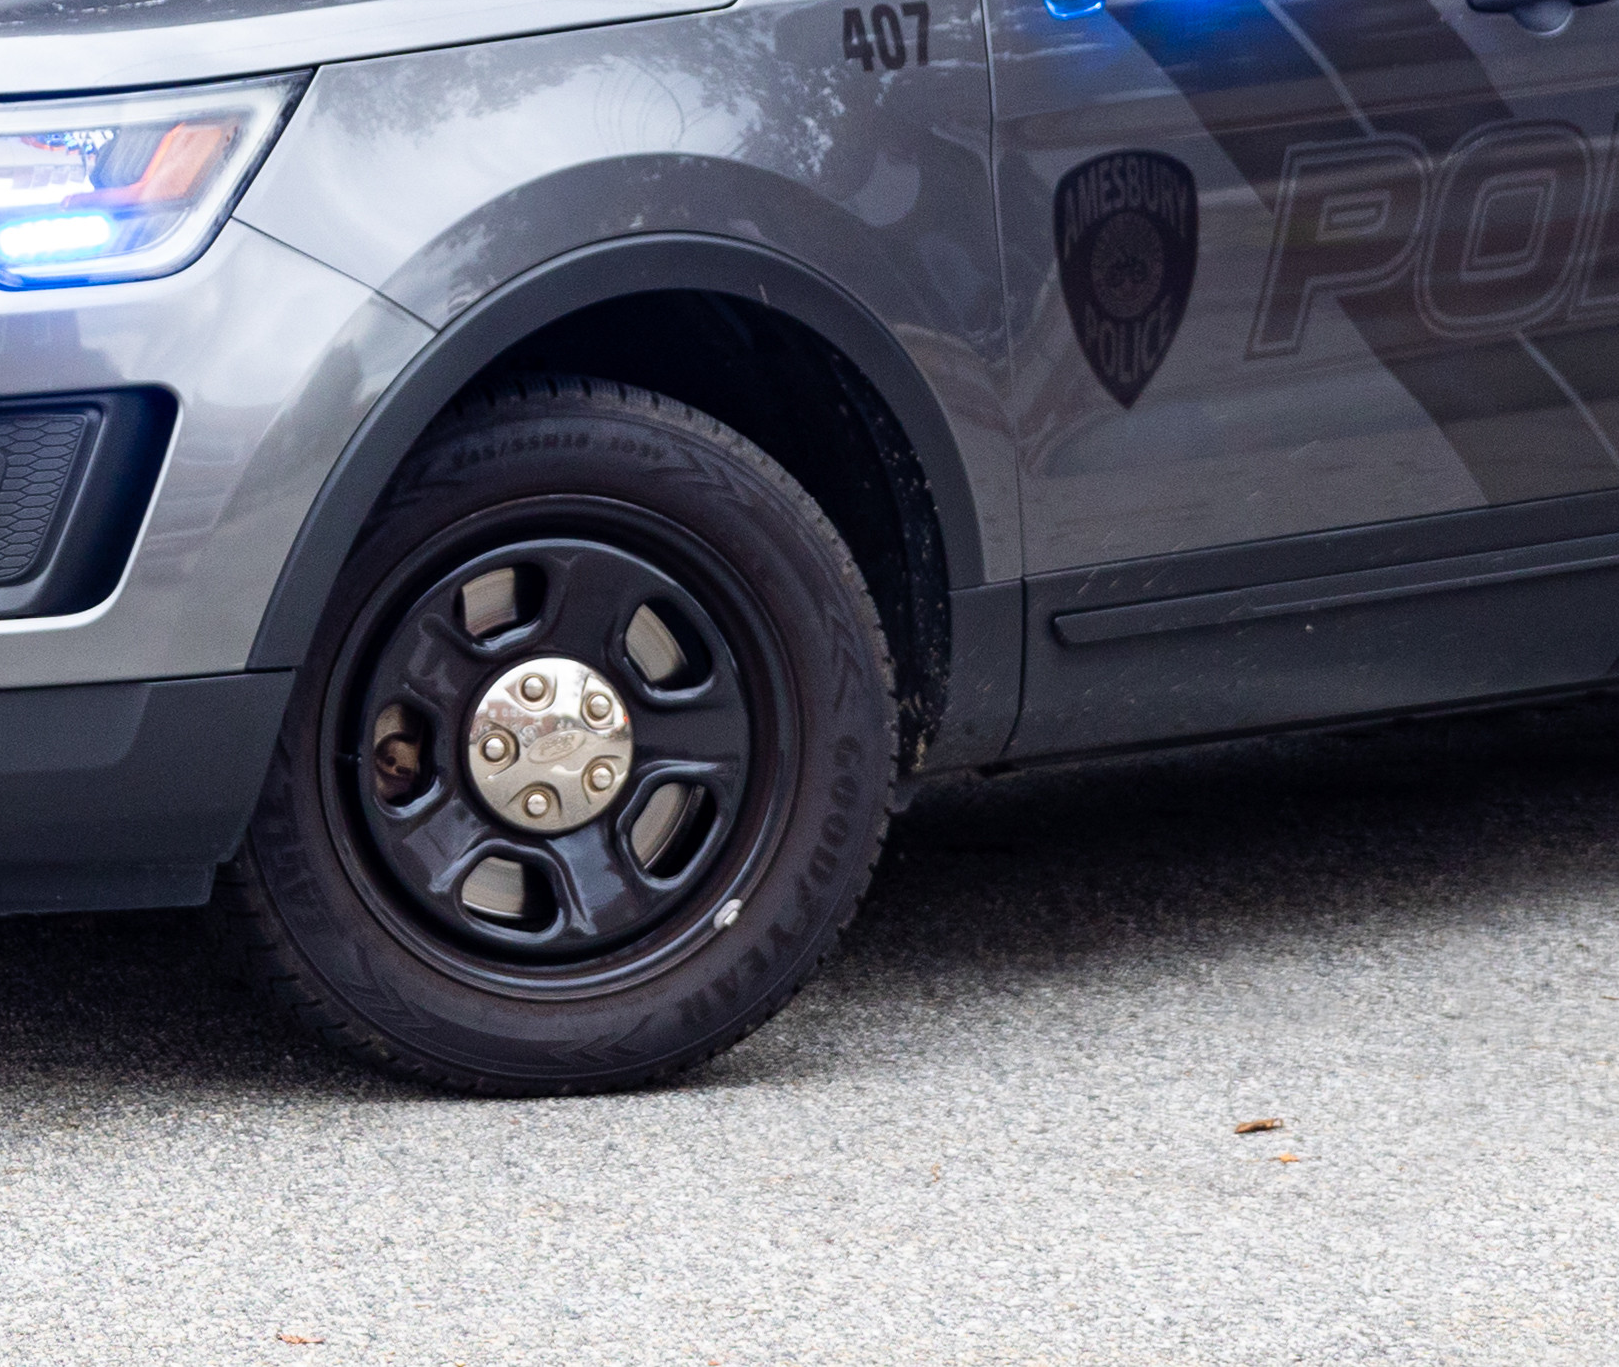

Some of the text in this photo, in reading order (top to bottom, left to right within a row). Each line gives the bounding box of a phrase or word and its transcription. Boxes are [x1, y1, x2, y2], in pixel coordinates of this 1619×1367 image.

[843, 0, 930, 72] 407
[1064, 155, 1188, 261] AMESBURY
[1085, 294, 1173, 385] POLICE
